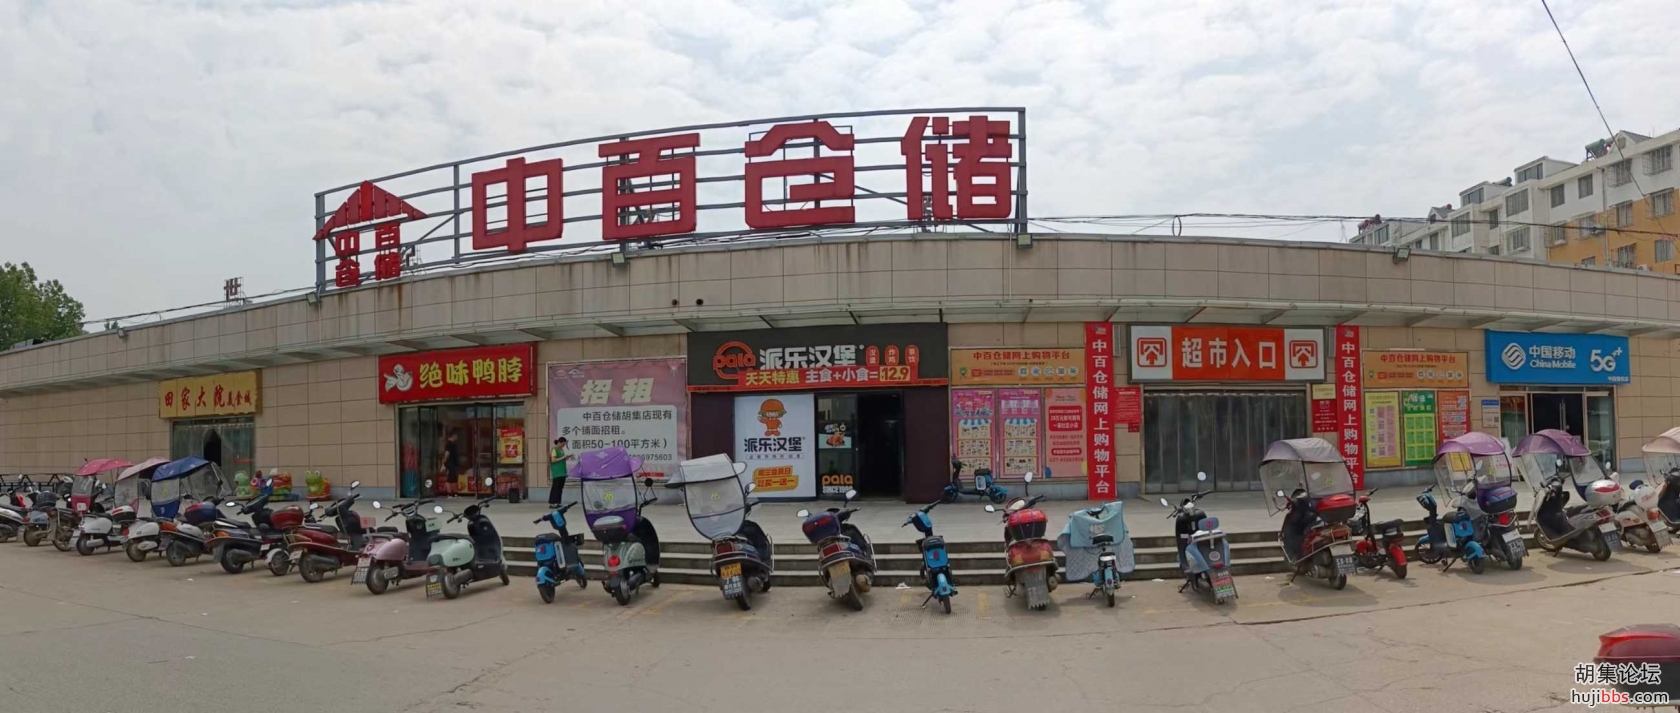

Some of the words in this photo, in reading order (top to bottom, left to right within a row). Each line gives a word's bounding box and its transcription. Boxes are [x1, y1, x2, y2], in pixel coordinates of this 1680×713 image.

[472, 115, 1012, 253] 中百仓储
[759, 344, 856, 369] 派乐汉堡
[973, 351, 1070, 361] 中百仓储网上购物平台
[1182, 337, 1277, 370] 超市入口
[1381, 353, 1456, 364] 中百仓储网上购物平台
[1529, 344, 1576, 359] 中国移动
[419, 356, 523, 389] 绝味鸭脖
[1529, 359, 1551, 368] China
[1552, 360, 1576, 369] Mobile
[745, 370, 800, 386] 天天特惠
[580, 377, 654, 405] 招租
[582, 409, 673, 422] 中百仓储胡集店现有
[1091, 339, 1110, 494] 中百仓储网上购物平台
[744, 436, 803, 453] 派乐汉堡
